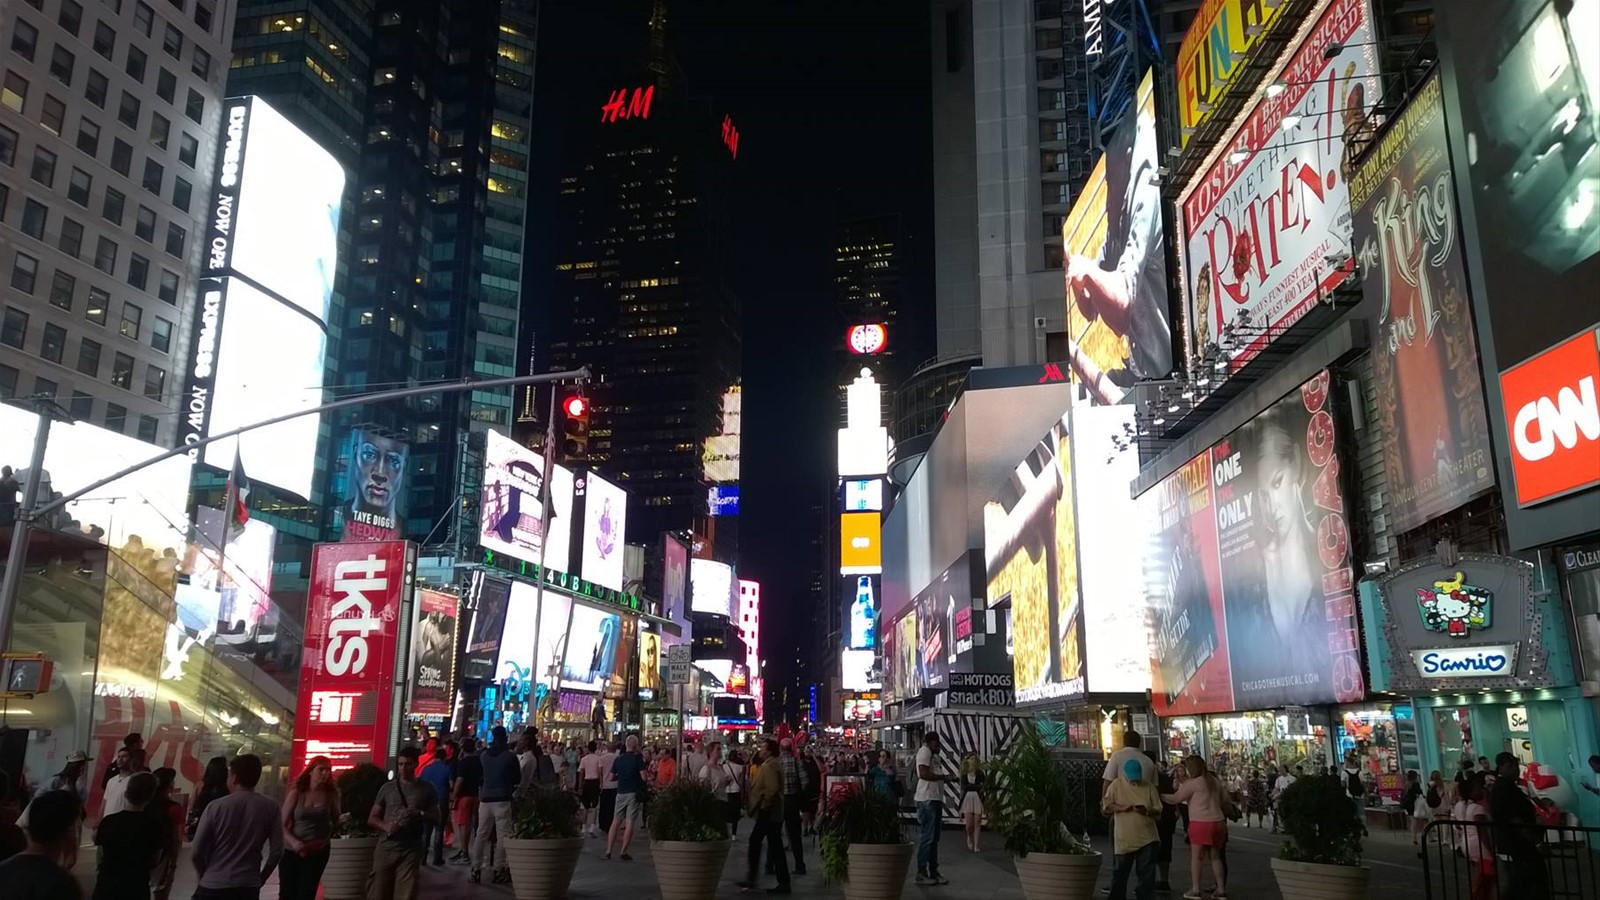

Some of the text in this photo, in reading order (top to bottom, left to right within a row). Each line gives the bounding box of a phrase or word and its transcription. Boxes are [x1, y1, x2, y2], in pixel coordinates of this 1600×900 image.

[1184, 3, 1232, 127] FUN
[601, 85, 655, 123] H&M
[1405, 75, 1440, 130] WINNER!
[214, 193, 234, 236] NOW
[208, 237, 228, 283] OPE
[1299, 239, 1331, 276] MUSICAL
[1373, 170, 1455, 325] King
[1387, 290, 1418, 356] and
[187, 385, 208, 432] NOW
[1513, 375, 1600, 462] CNN
[1214, 451, 1242, 487] ONE
[352, 510, 396, 530] TAYE DIGGS
[1219, 491, 1253, 530] ONLY
[1301, 369, 1365, 703] CHICAGO
[325, 553, 388, 677] tkts
[420, 665, 441, 682] SPRING
[670, 664, 688, 672] WALK
[964, 673, 1012, 687] HOT DOGS
[1423, 652, 1506, 674] Sanrio
[950, 688, 1014, 706] snackBOX
